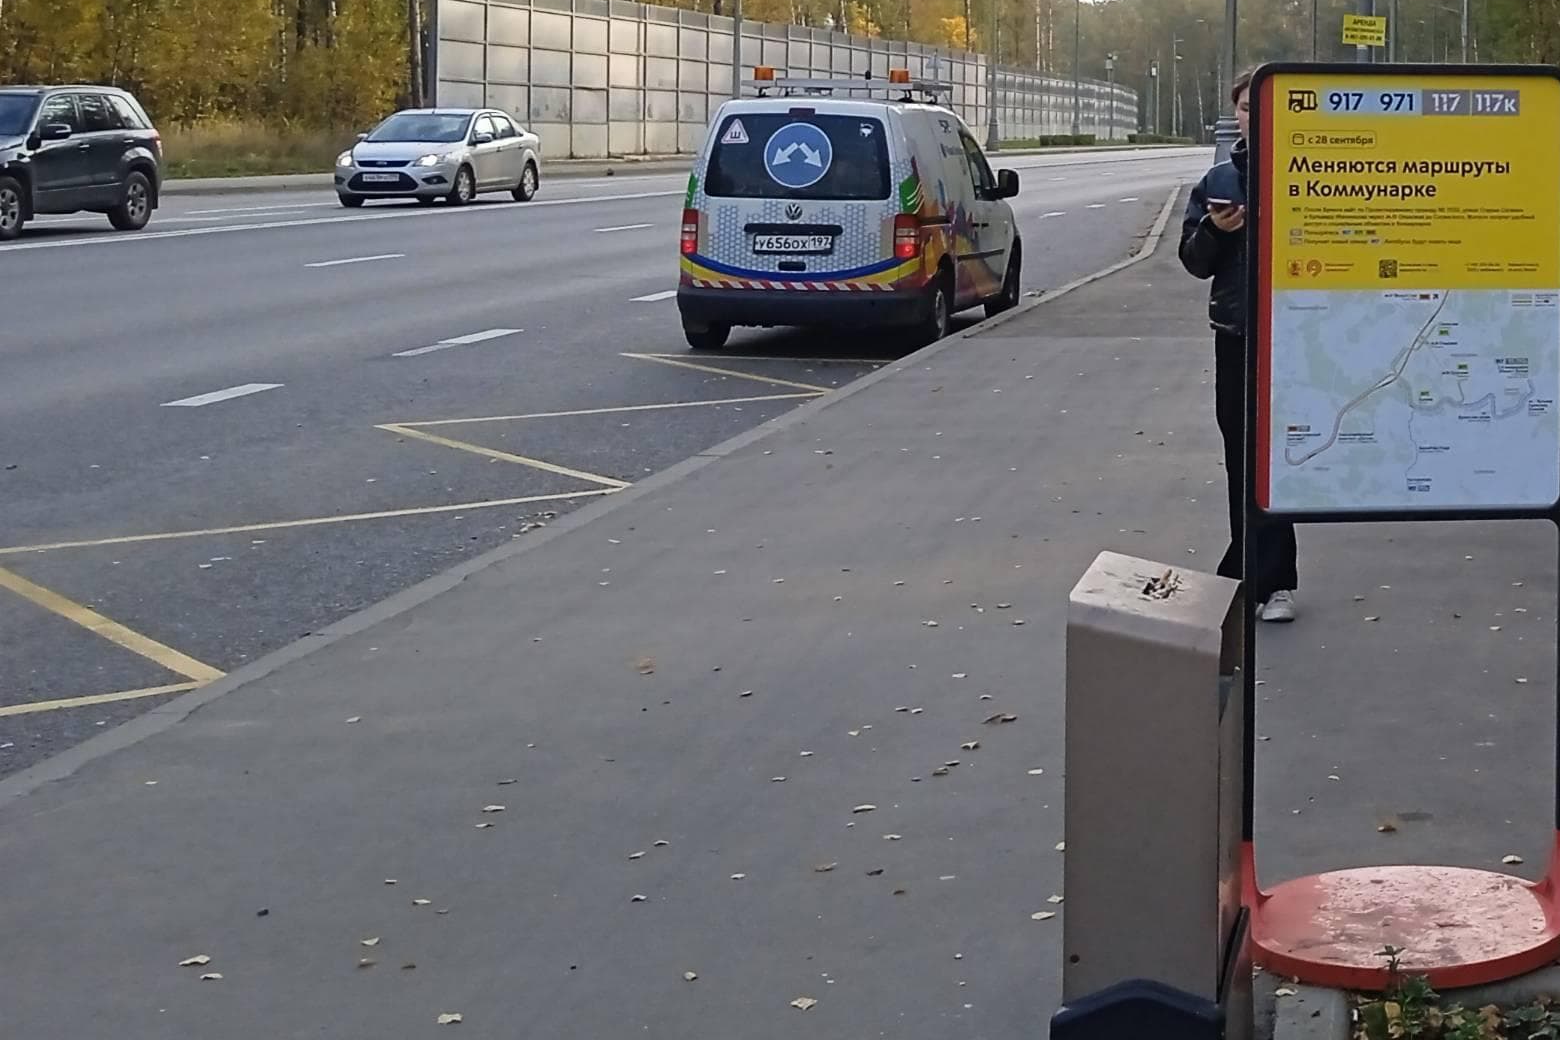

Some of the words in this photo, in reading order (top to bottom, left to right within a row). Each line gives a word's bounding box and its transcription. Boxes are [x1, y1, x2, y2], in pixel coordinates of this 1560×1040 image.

[1329, 93, 1363, 111] 917
[1380, 93, 1413, 111] 971
[1432, 94, 1461, 112] 117
[1315, 135, 1327, 144] 28
[1329, 134, 1373, 147] сентября
[1288, 157, 1396, 173] Меняются
[1402, 161, 1510, 177] маршруты
[1289, 185, 1299, 196] в
[1306, 180, 1436, 201] Коммунарке
[811, 236, 830, 247] 197
